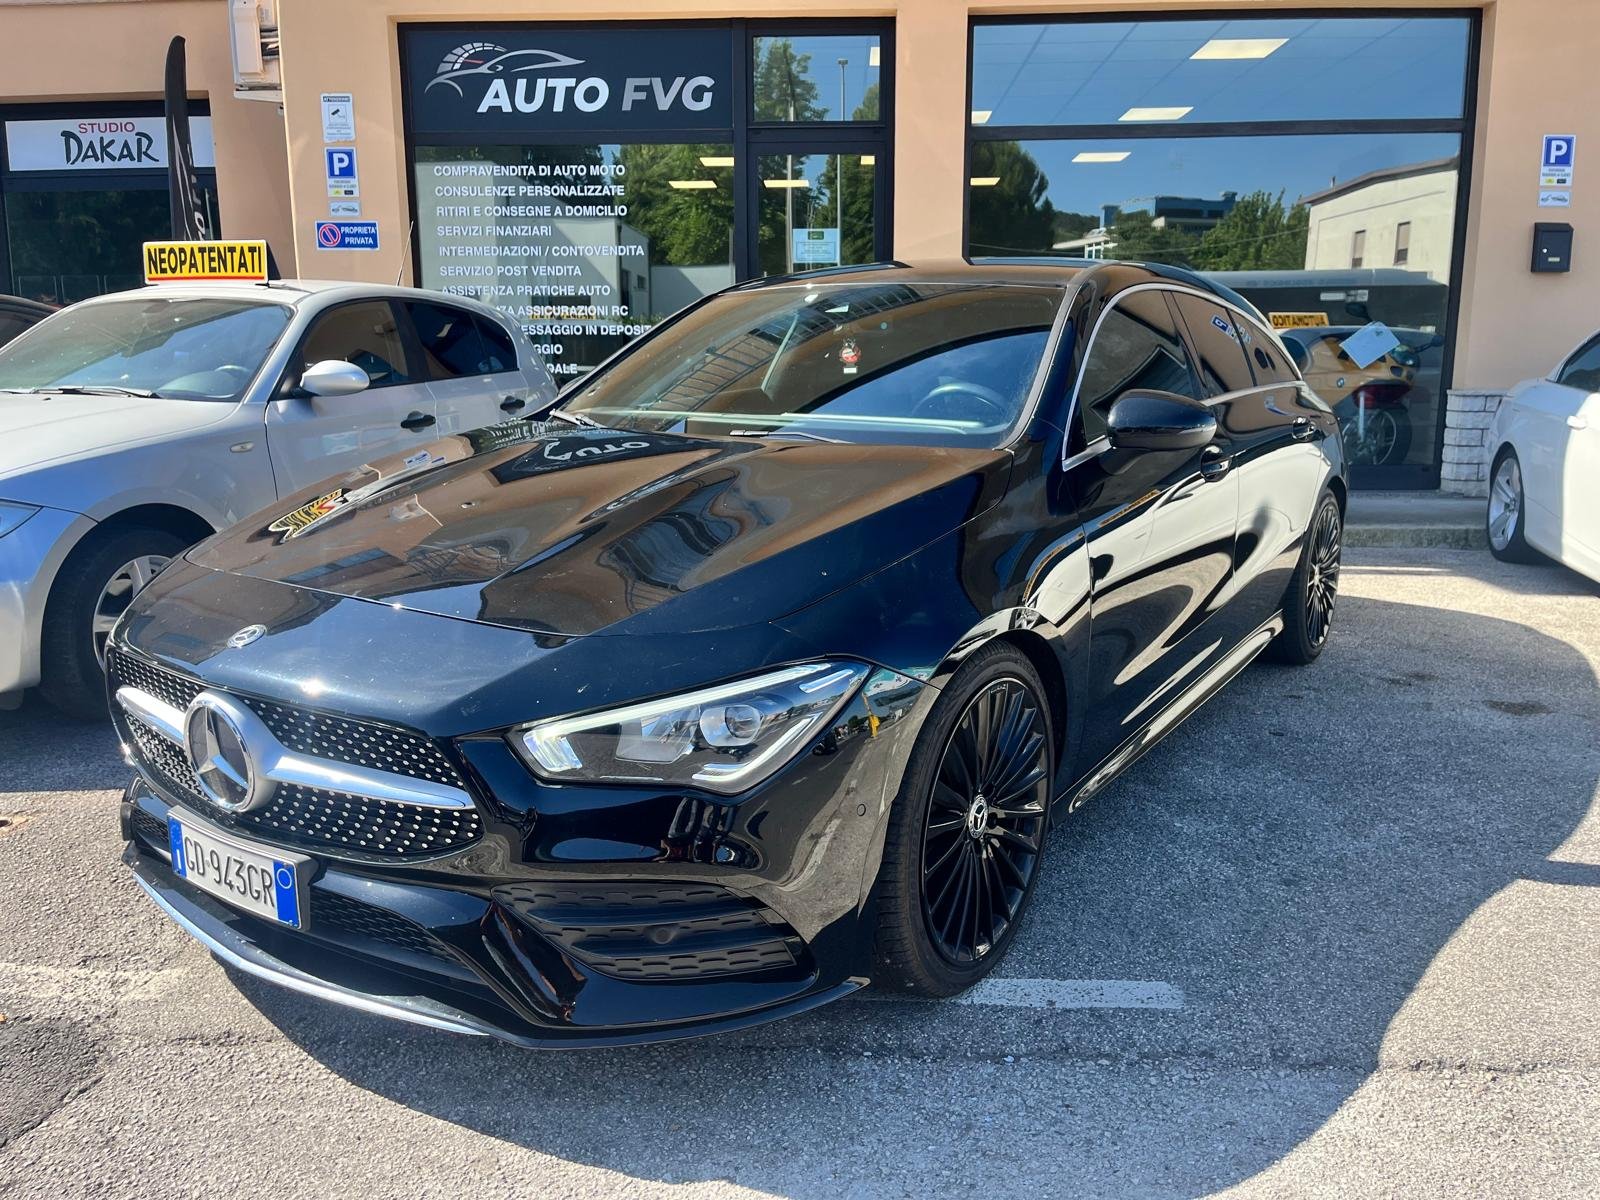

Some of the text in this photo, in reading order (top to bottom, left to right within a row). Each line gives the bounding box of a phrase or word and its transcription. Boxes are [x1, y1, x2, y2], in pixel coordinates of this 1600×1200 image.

[476, 75, 715, 113] AUTO FVG
[78, 121, 136, 134] STUDIO
[61, 130, 160, 166] DAKAR
[1549, 139, 1568, 164] P
[332, 152, 350, 176] P
[433, 165, 626, 177] COMPRAVENDITA DI AUTO MOTO
[435, 185, 625, 197] CONSULENZE PERSONALIZZATE
[436, 205, 628, 217] RITIRI E CONSEGNE A DOMICILIO
[436, 225, 552, 237] SERVIZI FINANZIARI
[344, 236, 374, 245] PRIVATA
[439, 246, 542, 257] INTERMEDIAZIONI
[551, 245, 645, 257] CONTOVENDITA
[147, 245, 263, 275] NEOPATENTATI
[439, 265, 582, 277] SERVIZIO POST VENDITA
[442, 285, 611, 296] ASSISTENZA PRATICHE AUTO
[517, 305, 609, 316] ASSICURAZIONI
[611, 305, 629, 316] RC
[520, 324, 652, 336] ESSAGGIO IN DEPOSIT
[533, 343, 564, 355] GGIO
[546, 363, 578, 374] DALE
